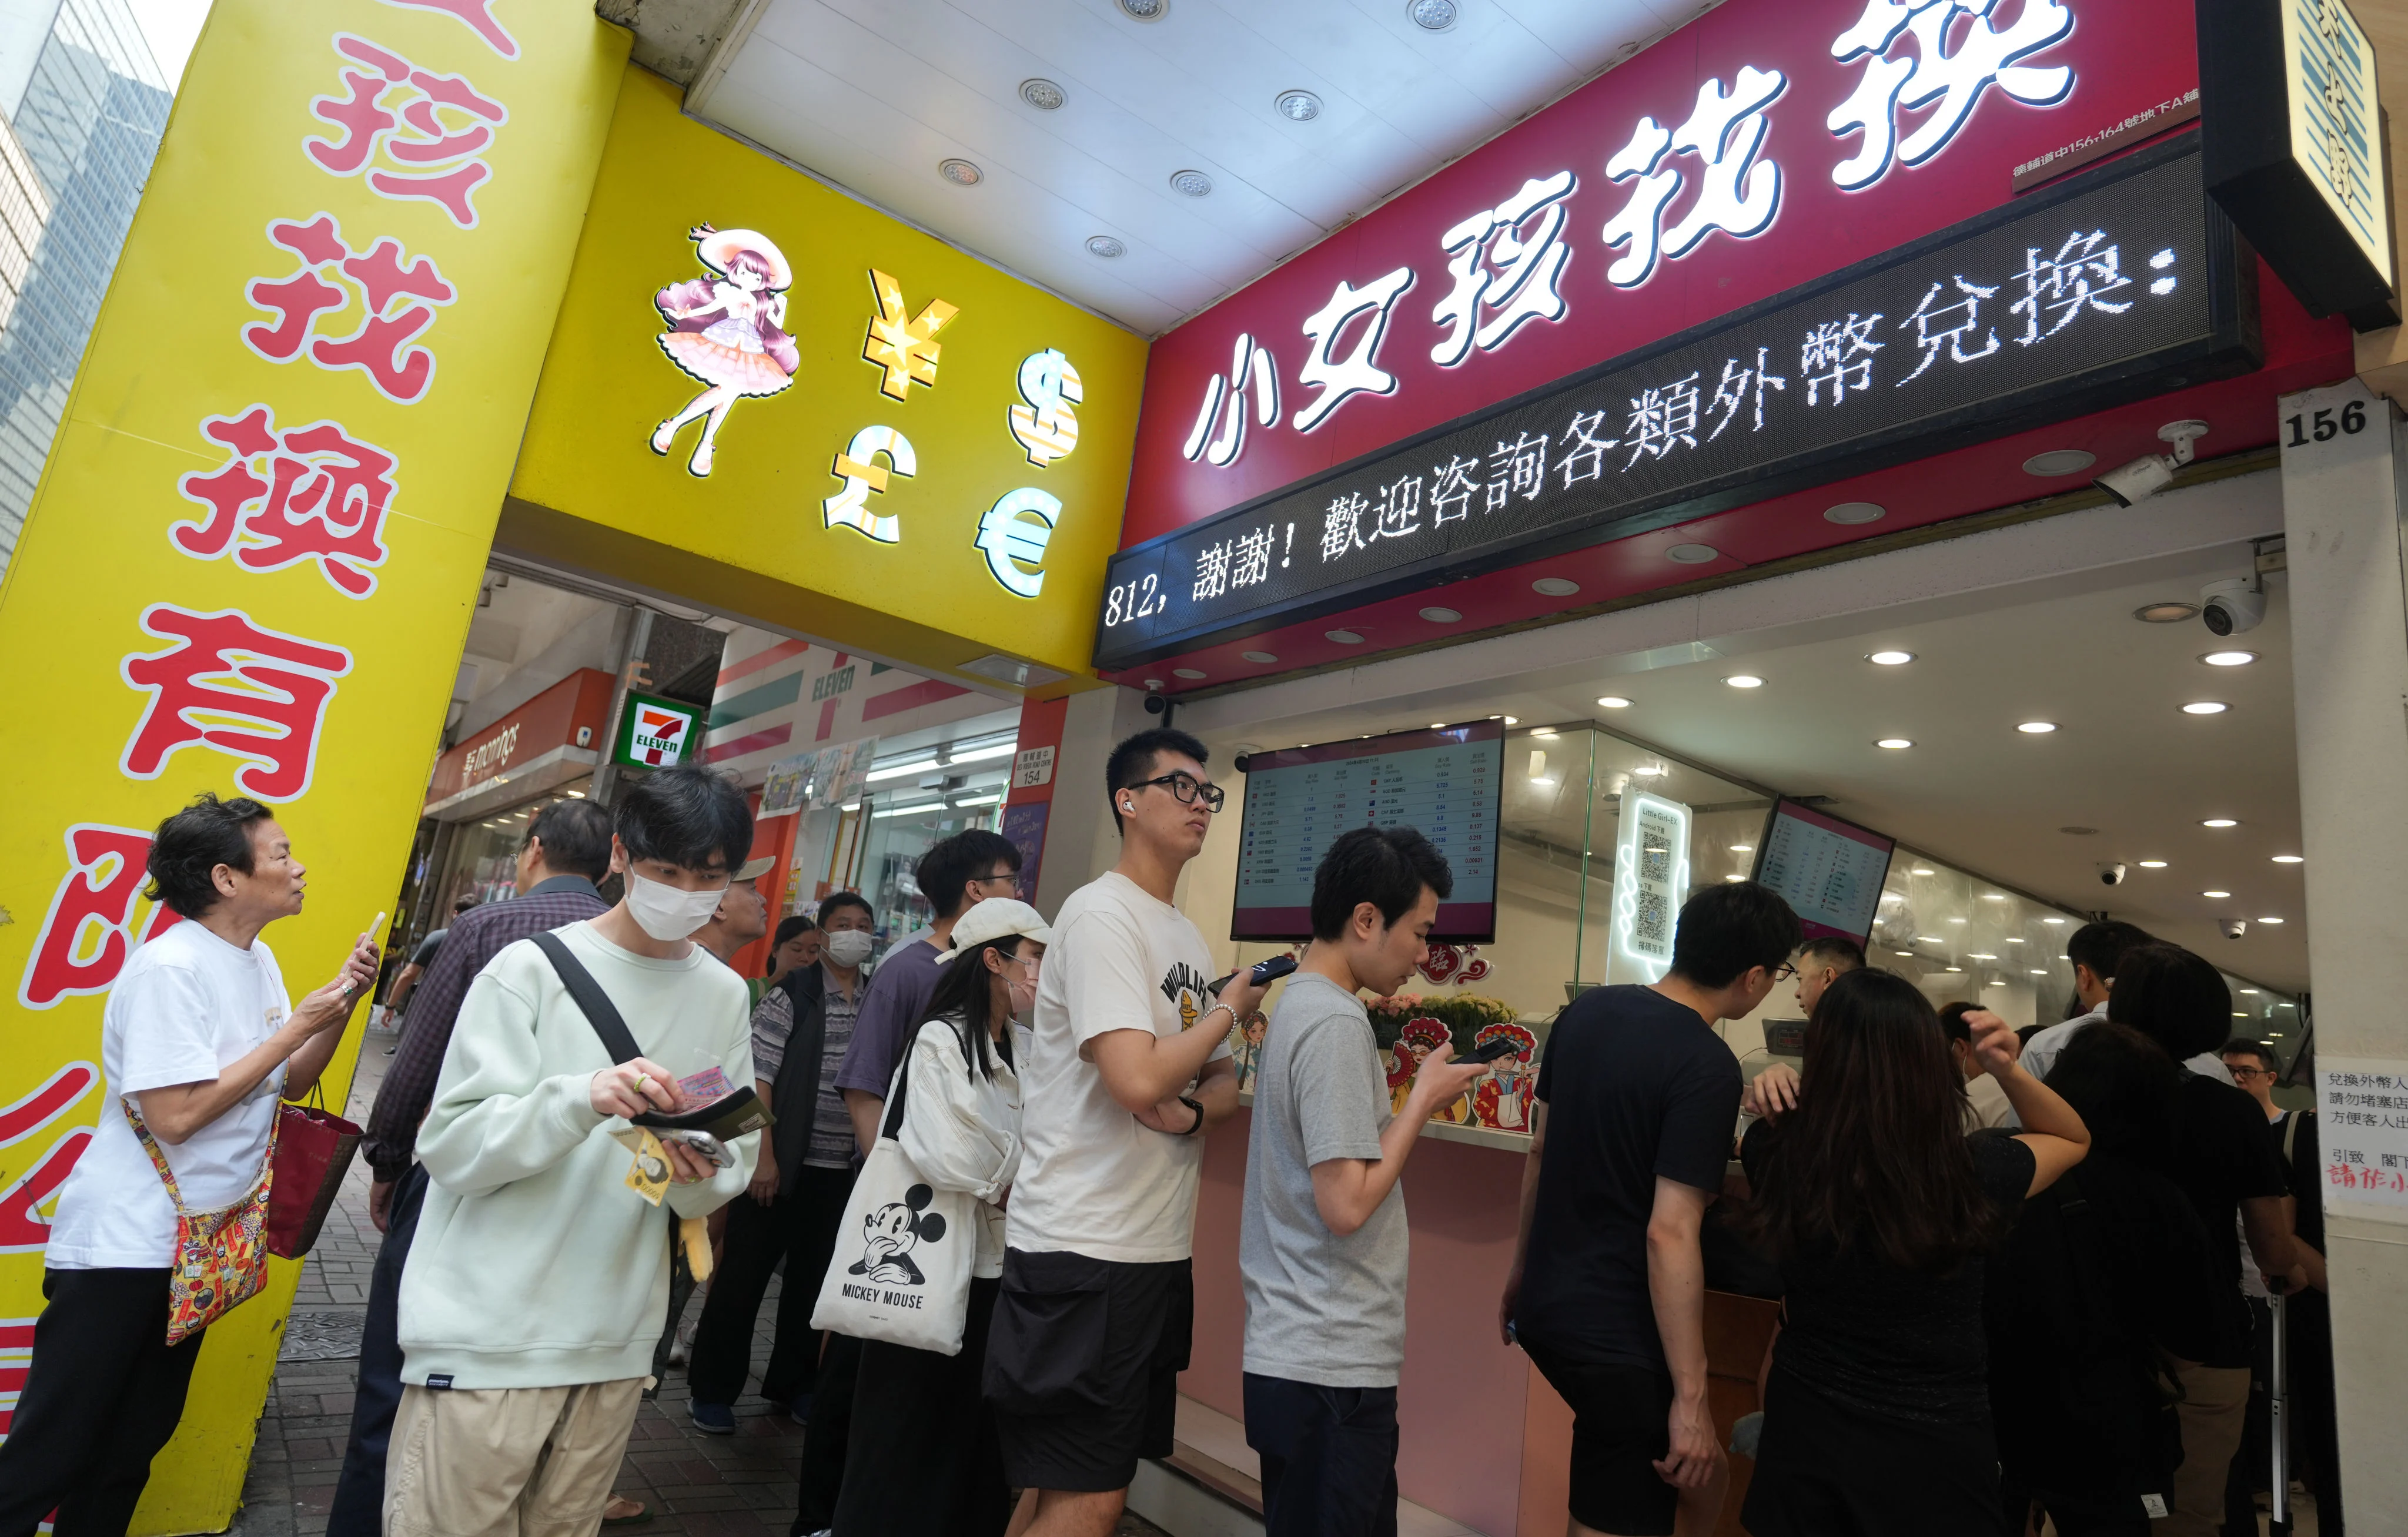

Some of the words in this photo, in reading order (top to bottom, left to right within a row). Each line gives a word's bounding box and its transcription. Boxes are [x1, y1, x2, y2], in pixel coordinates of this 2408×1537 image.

[1183, 0, 2076, 467] 小女孩找換
[2286, 400, 2366, 448] 156
[1025, 770, 1040, 785] 154
[1639, 821, 1656, 831] Android
[1643, 807, 1657, 819] Little
[1658, 812, 1678, 826] Girl-EX
[842, 1283, 880, 1303] MICKEY
[882, 1291, 924, 1310] MOUSE
